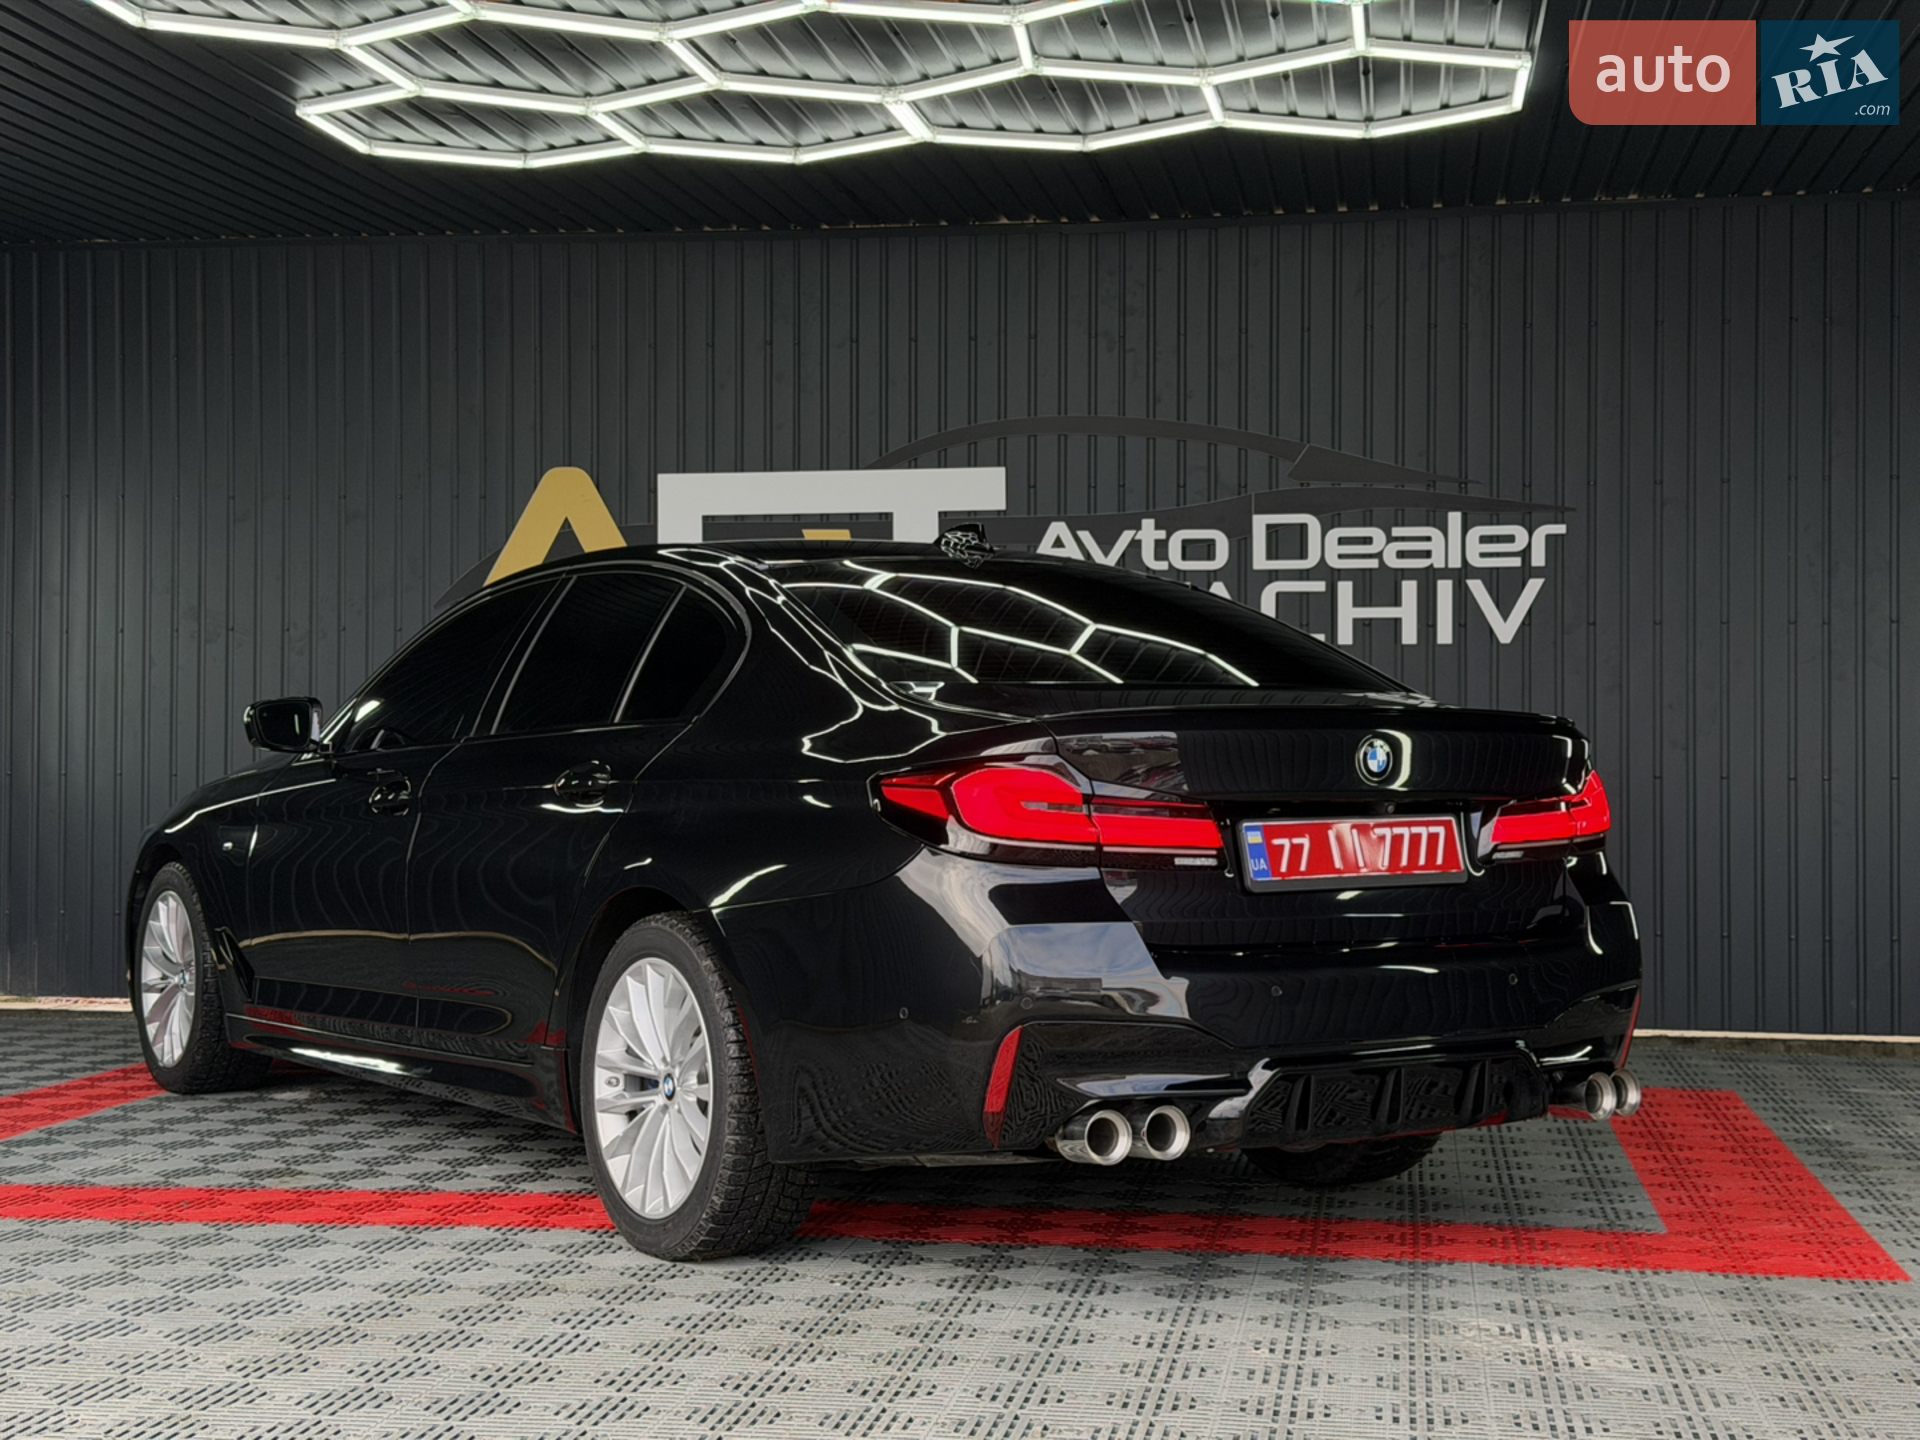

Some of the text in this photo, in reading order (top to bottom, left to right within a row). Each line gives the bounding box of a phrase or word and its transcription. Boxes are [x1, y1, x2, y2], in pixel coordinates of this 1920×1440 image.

[1035, 511, 1567, 571] Avto Dealer
[1251, 857, 1268, 871] UA
